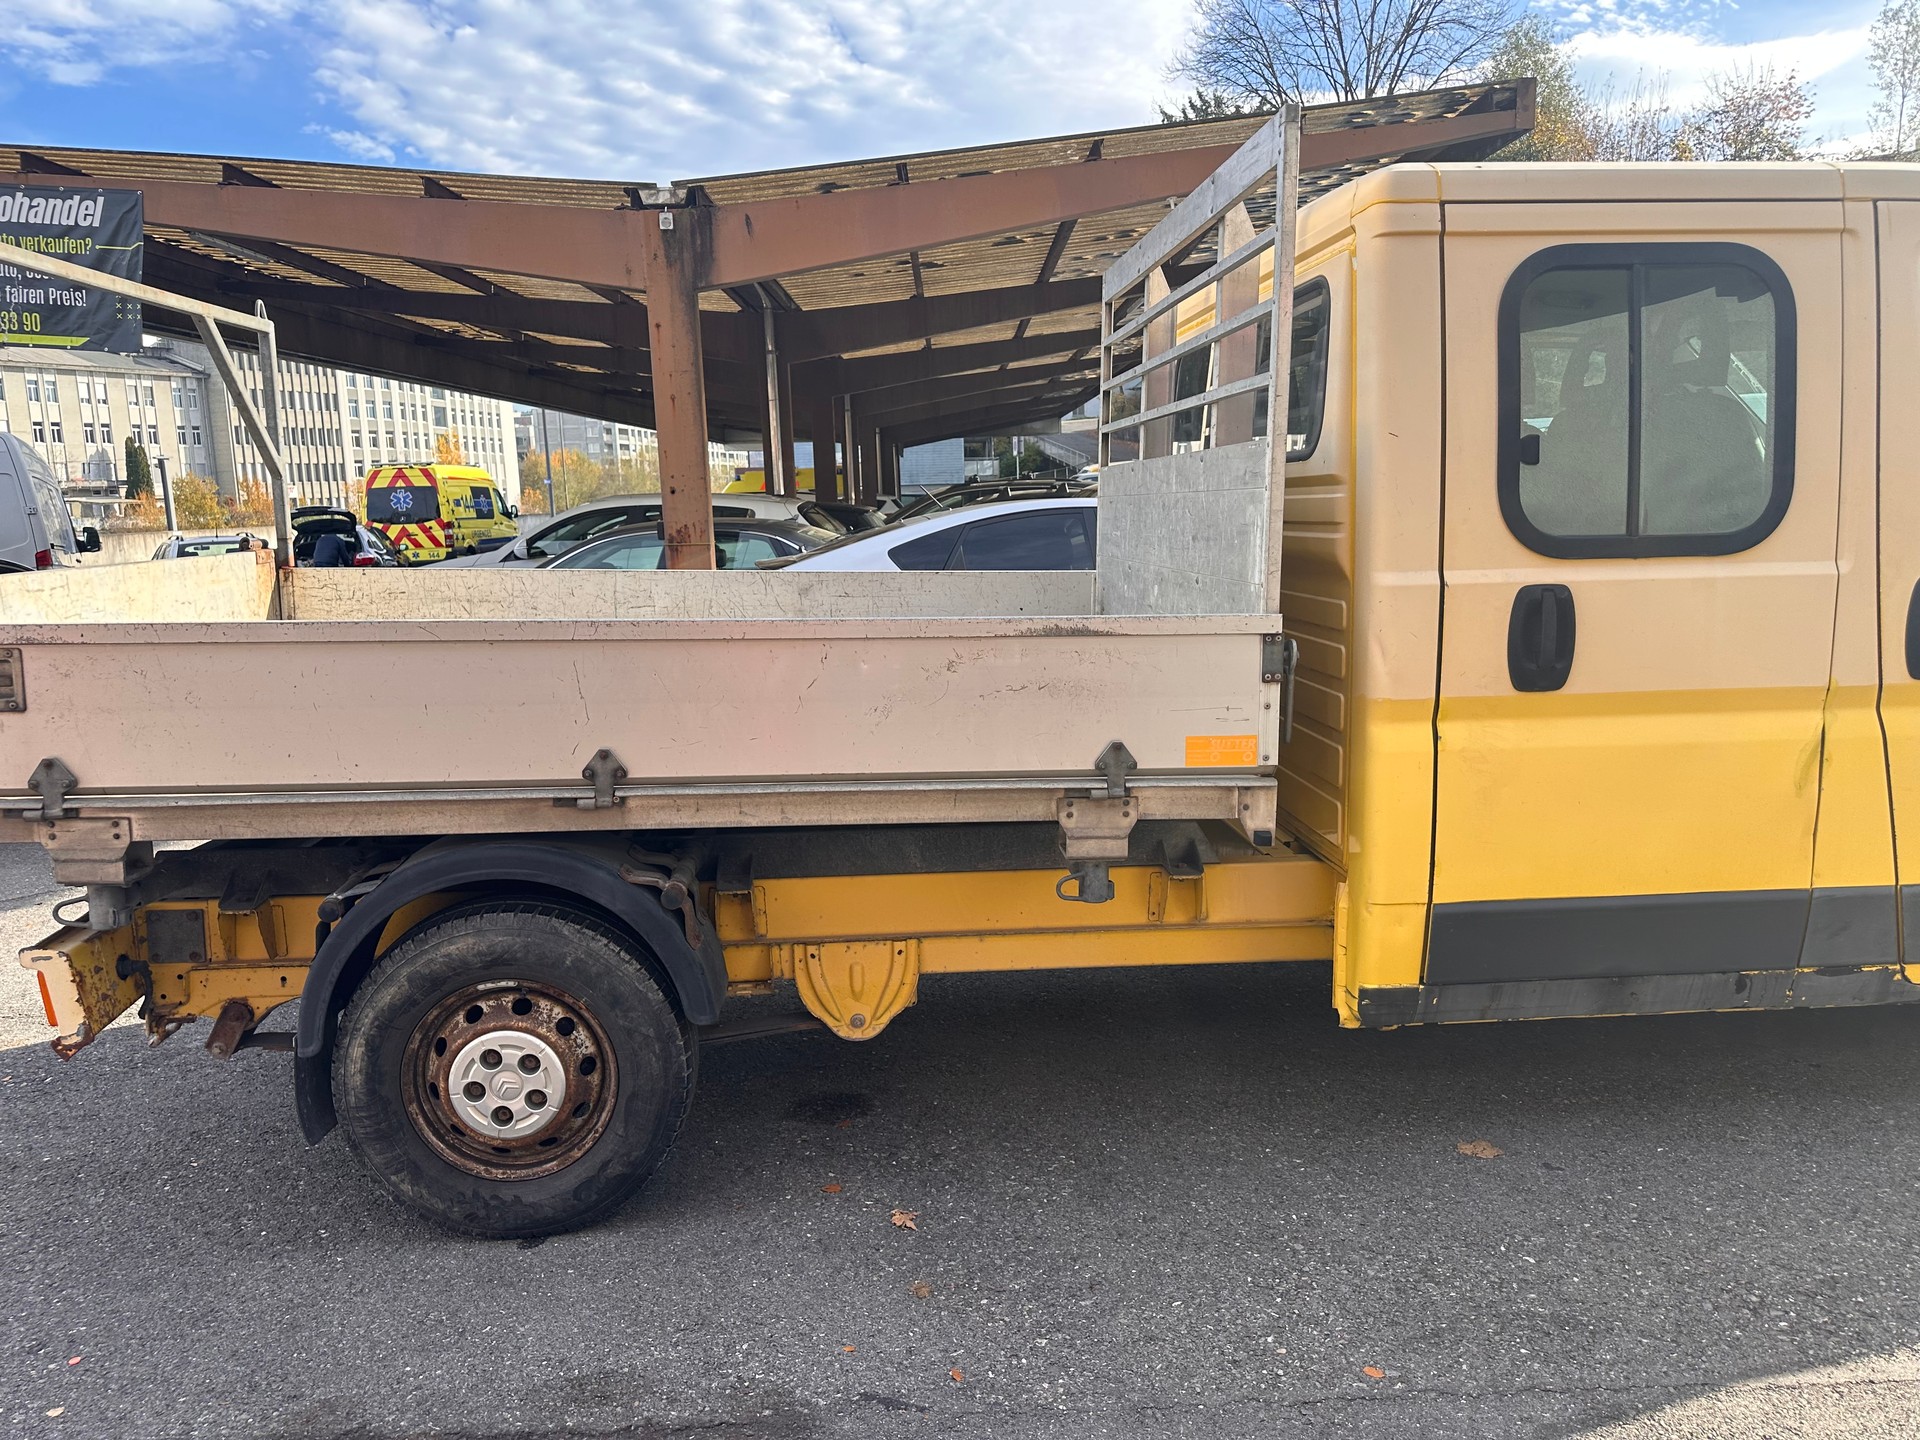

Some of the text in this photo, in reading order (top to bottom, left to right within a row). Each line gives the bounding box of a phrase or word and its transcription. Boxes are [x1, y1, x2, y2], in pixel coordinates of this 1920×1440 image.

[19, 235, 92, 255] verkaufen?
[5, 285, 86, 307] fairen Preis!
[23, 312, 41, 332] 90
[461, 494, 476, 513] 144
